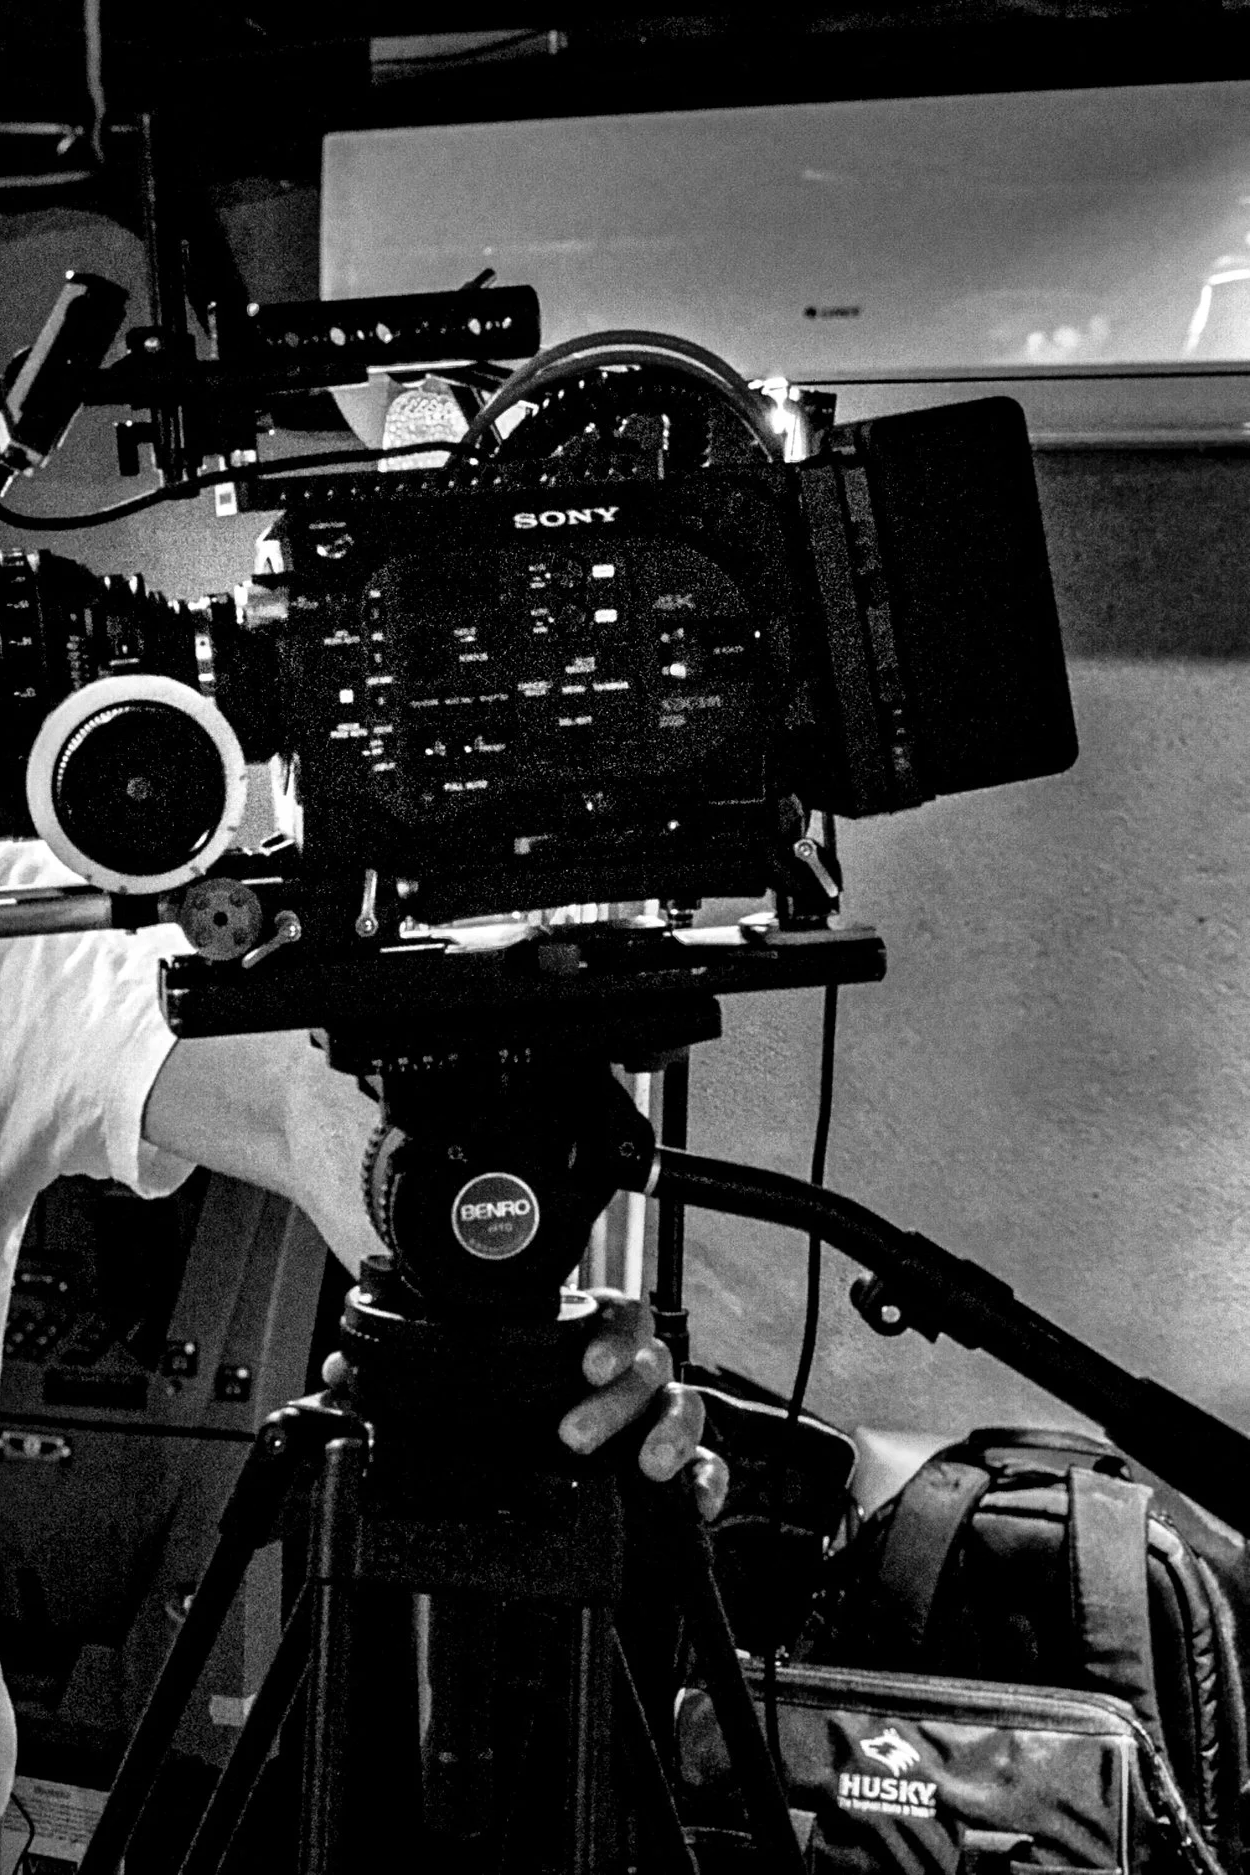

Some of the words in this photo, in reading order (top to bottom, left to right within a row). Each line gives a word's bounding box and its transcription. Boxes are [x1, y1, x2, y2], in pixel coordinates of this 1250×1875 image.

[513, 506, 619, 529] SONY
[461, 1199, 530, 1221] BENRO
[838, 1773, 937, 1805] HUSKY
